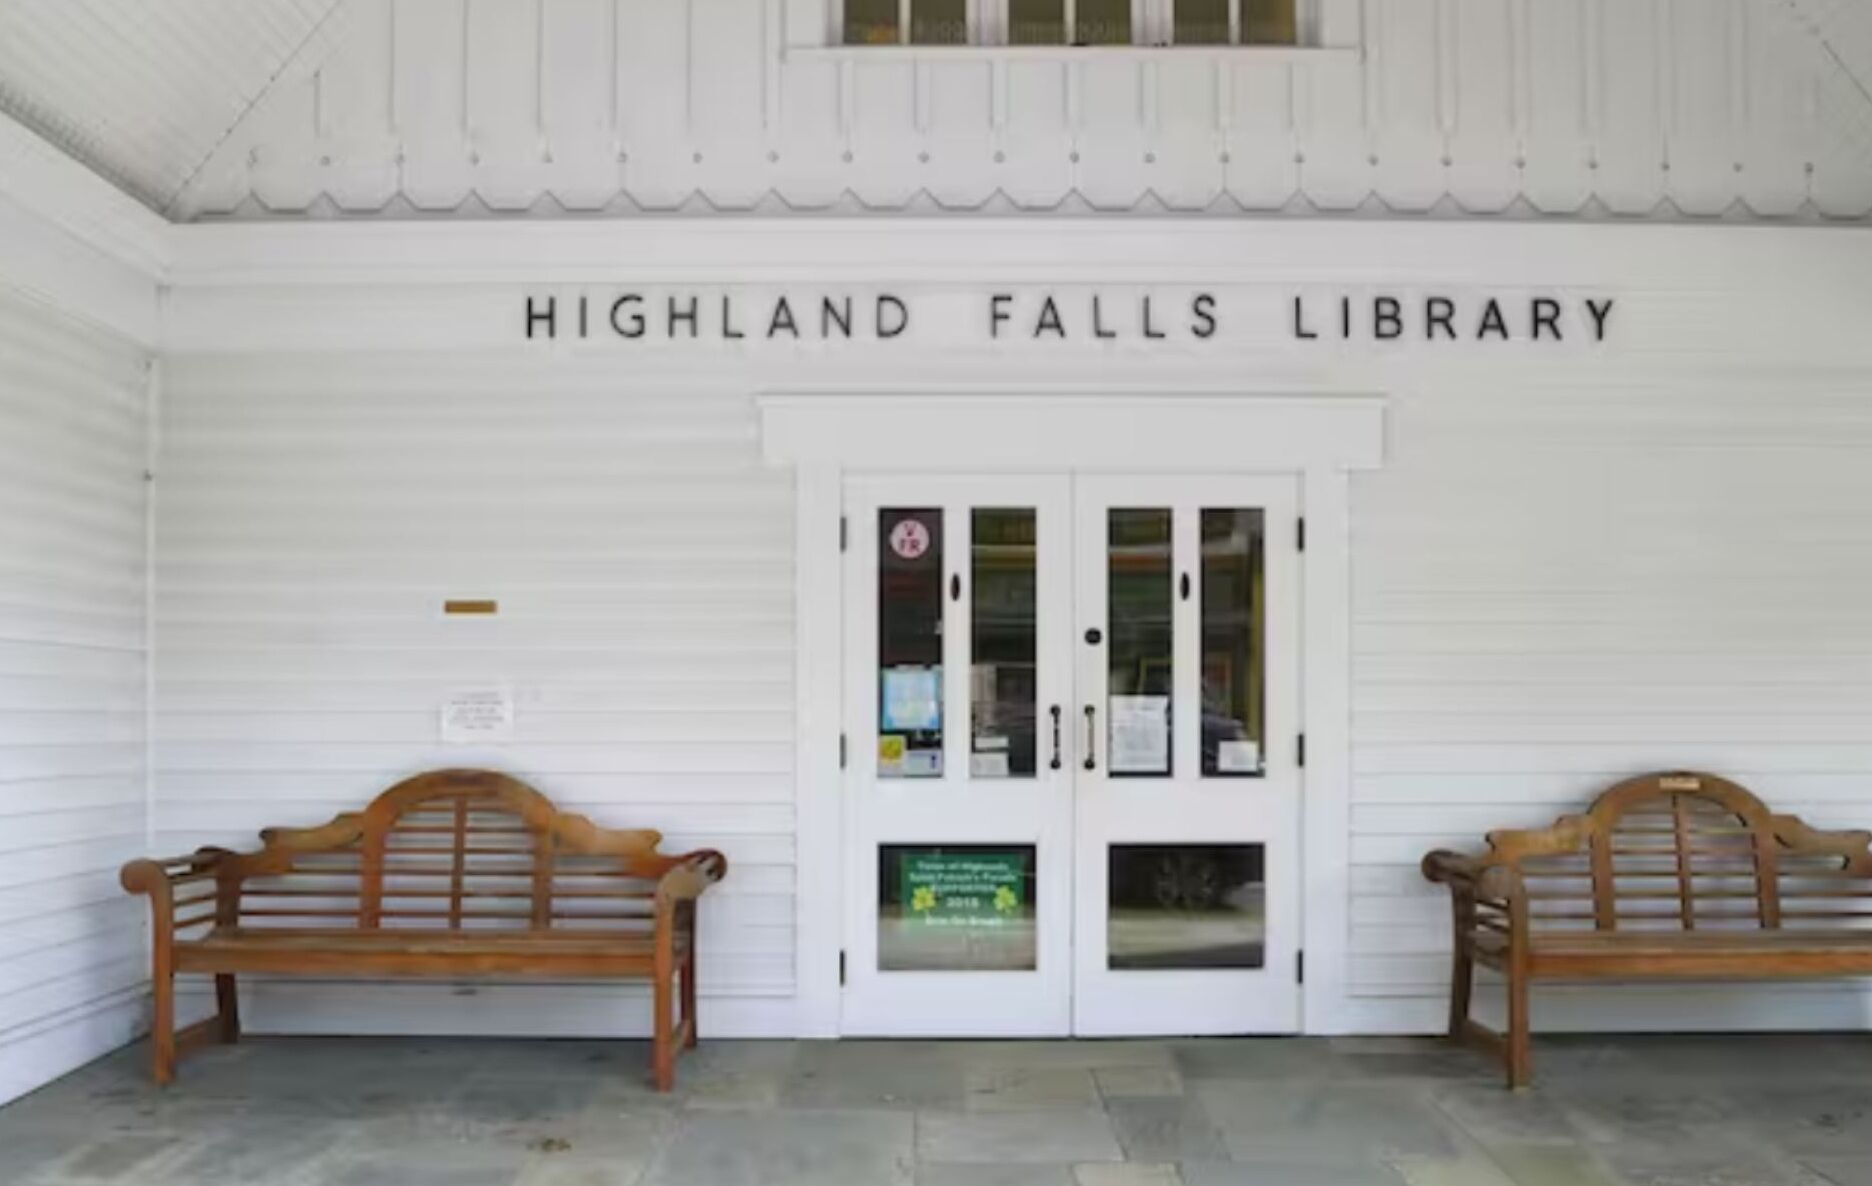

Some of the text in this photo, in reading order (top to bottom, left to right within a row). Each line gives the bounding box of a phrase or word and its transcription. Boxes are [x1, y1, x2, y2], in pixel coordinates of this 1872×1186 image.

[525, 293, 1615, 342] HIGHLAND FALLS LIBRARY
